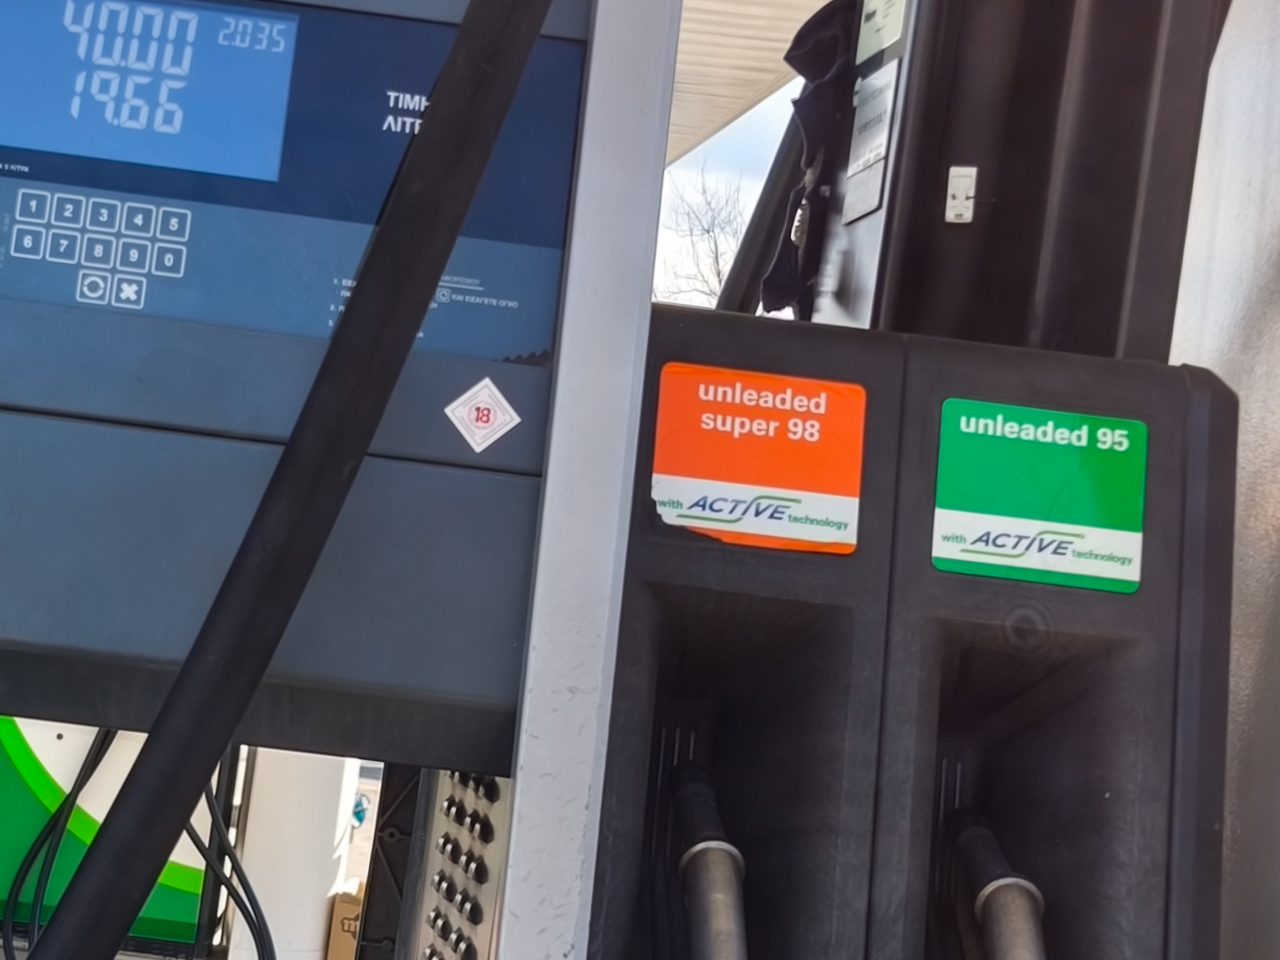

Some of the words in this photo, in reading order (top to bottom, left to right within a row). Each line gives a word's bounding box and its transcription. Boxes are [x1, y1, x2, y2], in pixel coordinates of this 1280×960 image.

[218, 16, 287, 52] 2.035
[71, 70, 187, 135] 19.66
[29, 199, 37, 213] 1
[64, 204, 73, 217] 2
[99, 209, 108, 222] 3
[133, 213, 143, 227] 4
[169, 217, 179, 231] 5
[23, 235, 33, 249] 6
[59, 239, 69, 253] 7
[94, 244, 104, 257] 8
[129, 248, 139, 262] 9
[164, 253, 174, 267] 0
[698, 381, 826, 414] unleaded
[475, 406, 491, 424] 18
[701, 411, 779, 440] super
[787, 418, 821, 443] 98
[960, 414, 1088, 448] unleaded
[1096, 429, 1129, 451] 95
[658, 497, 683, 510] with
[687, 495, 791, 520] ACTIVE
[788, 513, 849, 531] technology
[941, 533, 966, 545] with
[970, 531, 1073, 556] ACTIVE
[1072, 549, 1133, 567] technology
